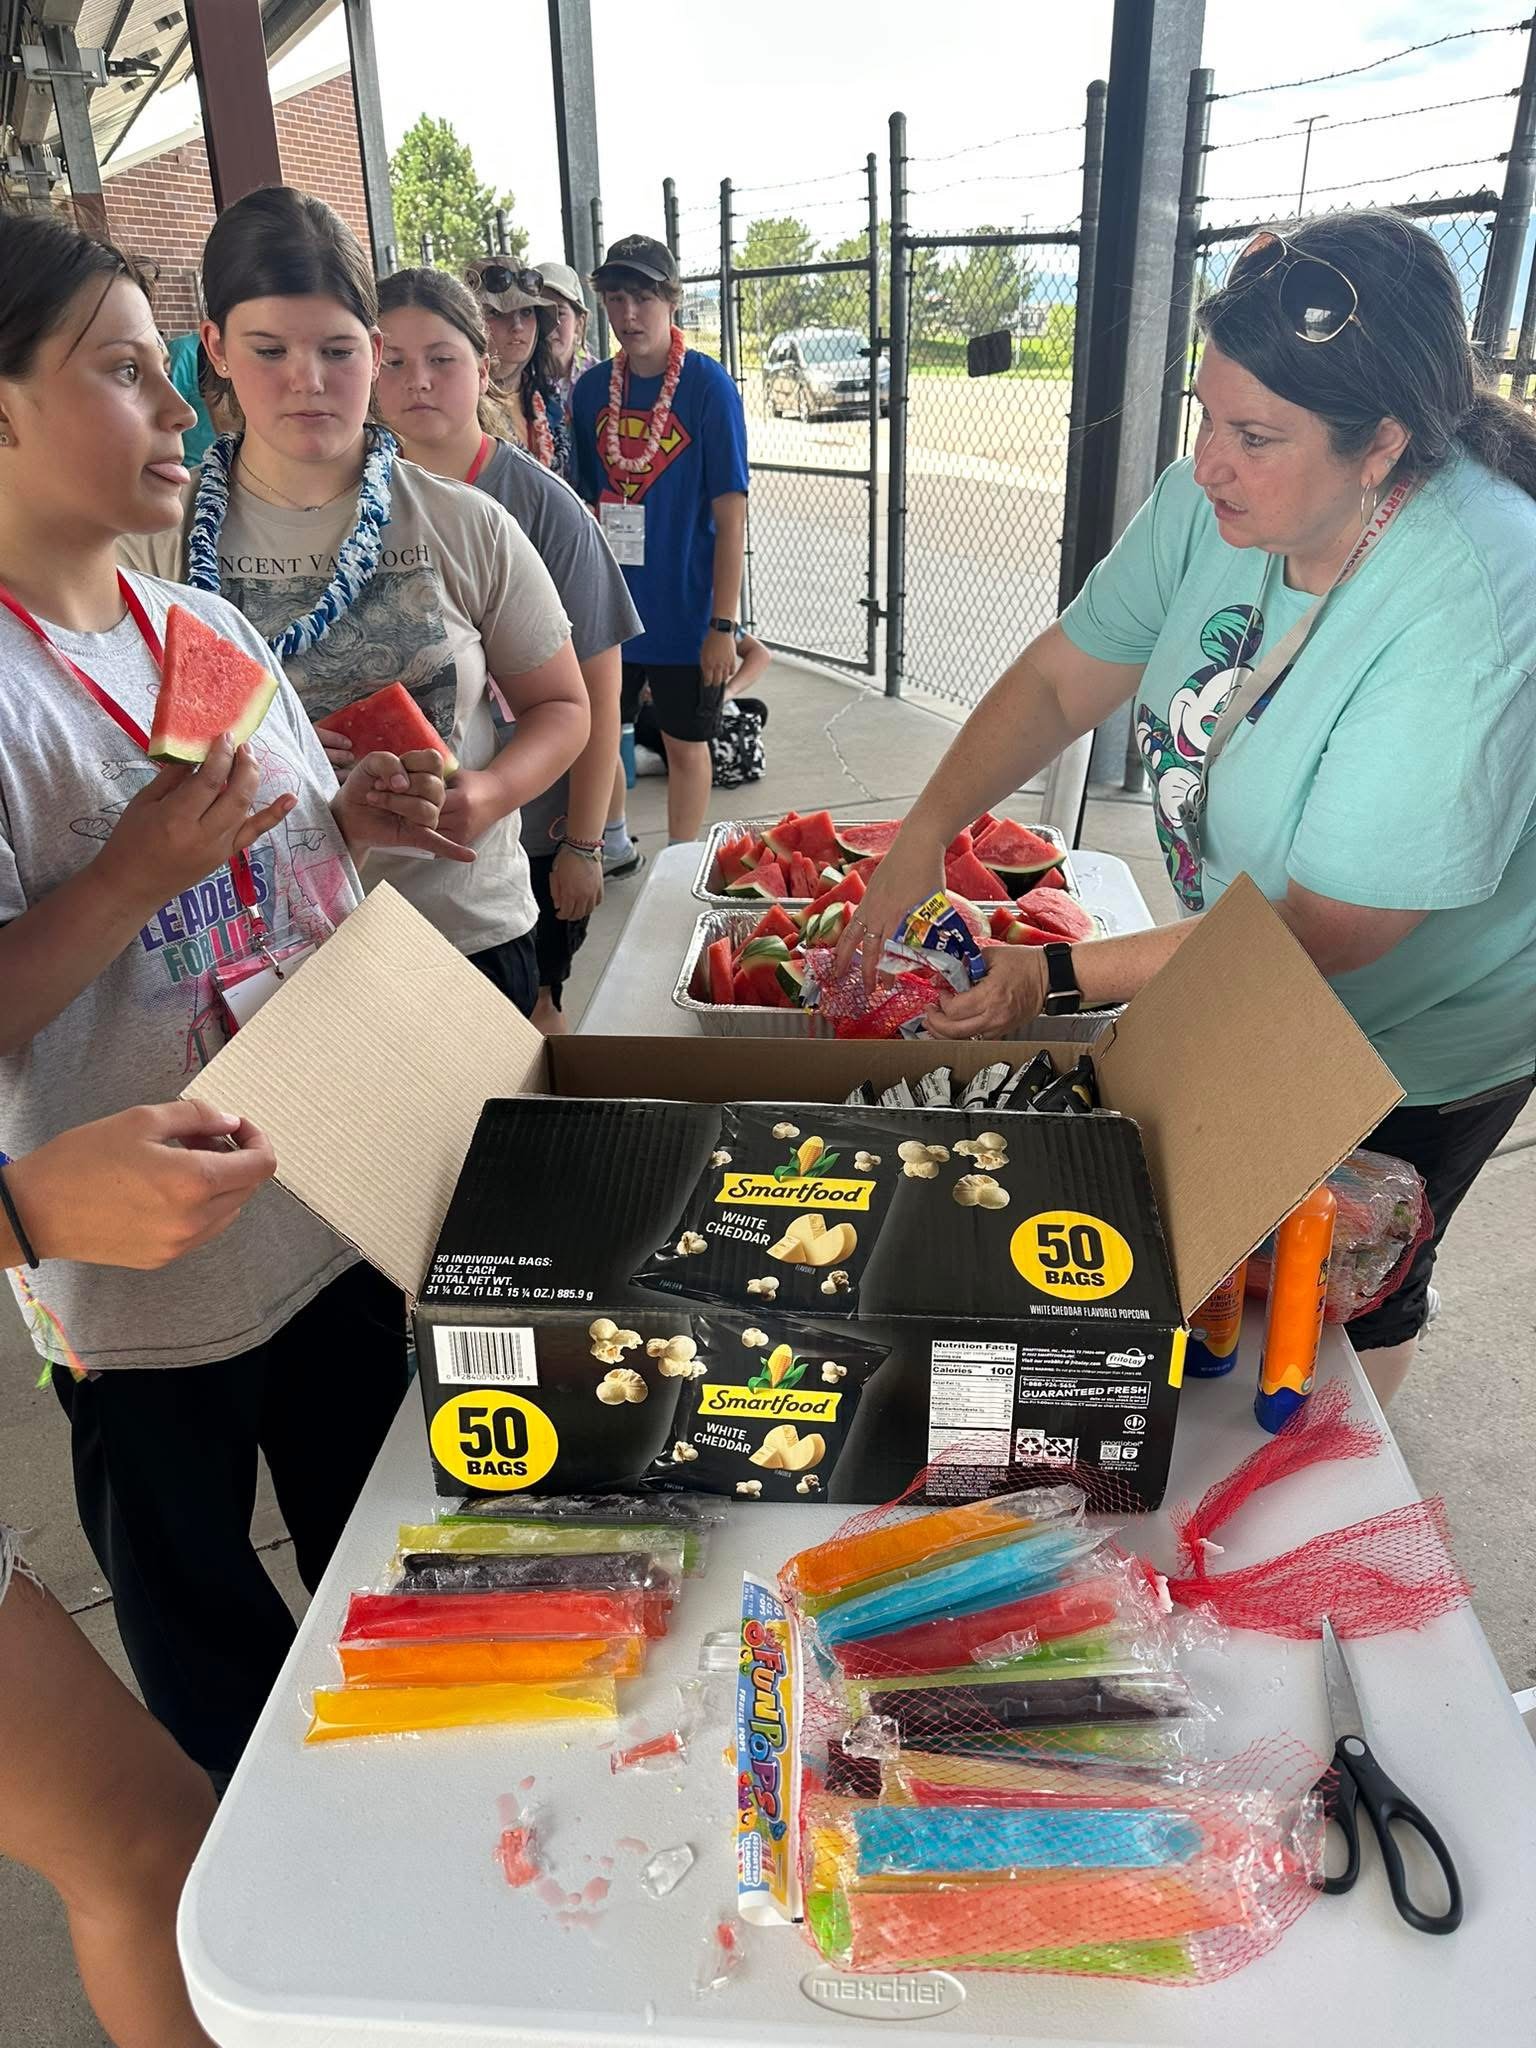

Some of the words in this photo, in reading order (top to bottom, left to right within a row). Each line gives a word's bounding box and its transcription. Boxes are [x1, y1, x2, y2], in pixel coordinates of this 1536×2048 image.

[219, 555, 302, 574] NCENT
[309, 553, 338, 572] VA
[382, 544, 430, 567] OGH
[728, 1178, 863, 1203] Smartfood
[722, 1211, 767, 1230] WHITE
[705, 1222, 771, 1246] CHEDDAR
[1037, 1224, 1105, 1270] 50
[436, 1254, 449, 1263] 50
[451, 1255, 516, 1265] INDIVIDUAL
[518, 1257, 553, 1266] BAGS:
[445, 1265, 463, 1274] OZ.
[465, 1266, 497, 1275] EACH
[431, 1275, 465, 1284] TOTAL
[467, 1276, 491, 1285] NET
[492, 1277, 513, 1286] WT.
[1045, 1271, 1105, 1287] BAGS
[426, 1285, 439, 1295] 31
[453, 1286, 471, 1295] OZ.
[473, 1286, 484, 1296] (1
[486, 1287, 504, 1296] LB.
[507, 1287, 519, 1297] 15
[533, 1288, 555, 1299] OZ.)
[557, 1289, 585, 1299] 885.9
[586, 1291, 594, 1301] g
[1030, 1304, 1051, 1316] WHITE
[1051, 1305, 1083, 1317] CHEDDAR
[1084, 1307, 1118, 1318] FLAVORED
[1119, 1308, 1151, 1320] POPCORN
[934, 1342, 982, 1350] Nutrition
[985, 1343, 1016, 1351] Facts
[990, 1367, 1014, 1376] 100
[1022, 1387, 1105, 1398] GUARANTEED
[1106, 1386, 1147, 1395] FRESH
[708, 1390, 830, 1415] Smartfood
[458, 1406, 529, 1459] 50
[706, 1422, 747, 1441] WHITE
[694, 1433, 751, 1455] CHEDDAR
[467, 1460, 528, 1476] BAGS
[812, 1977, 946, 2004] maxchief
